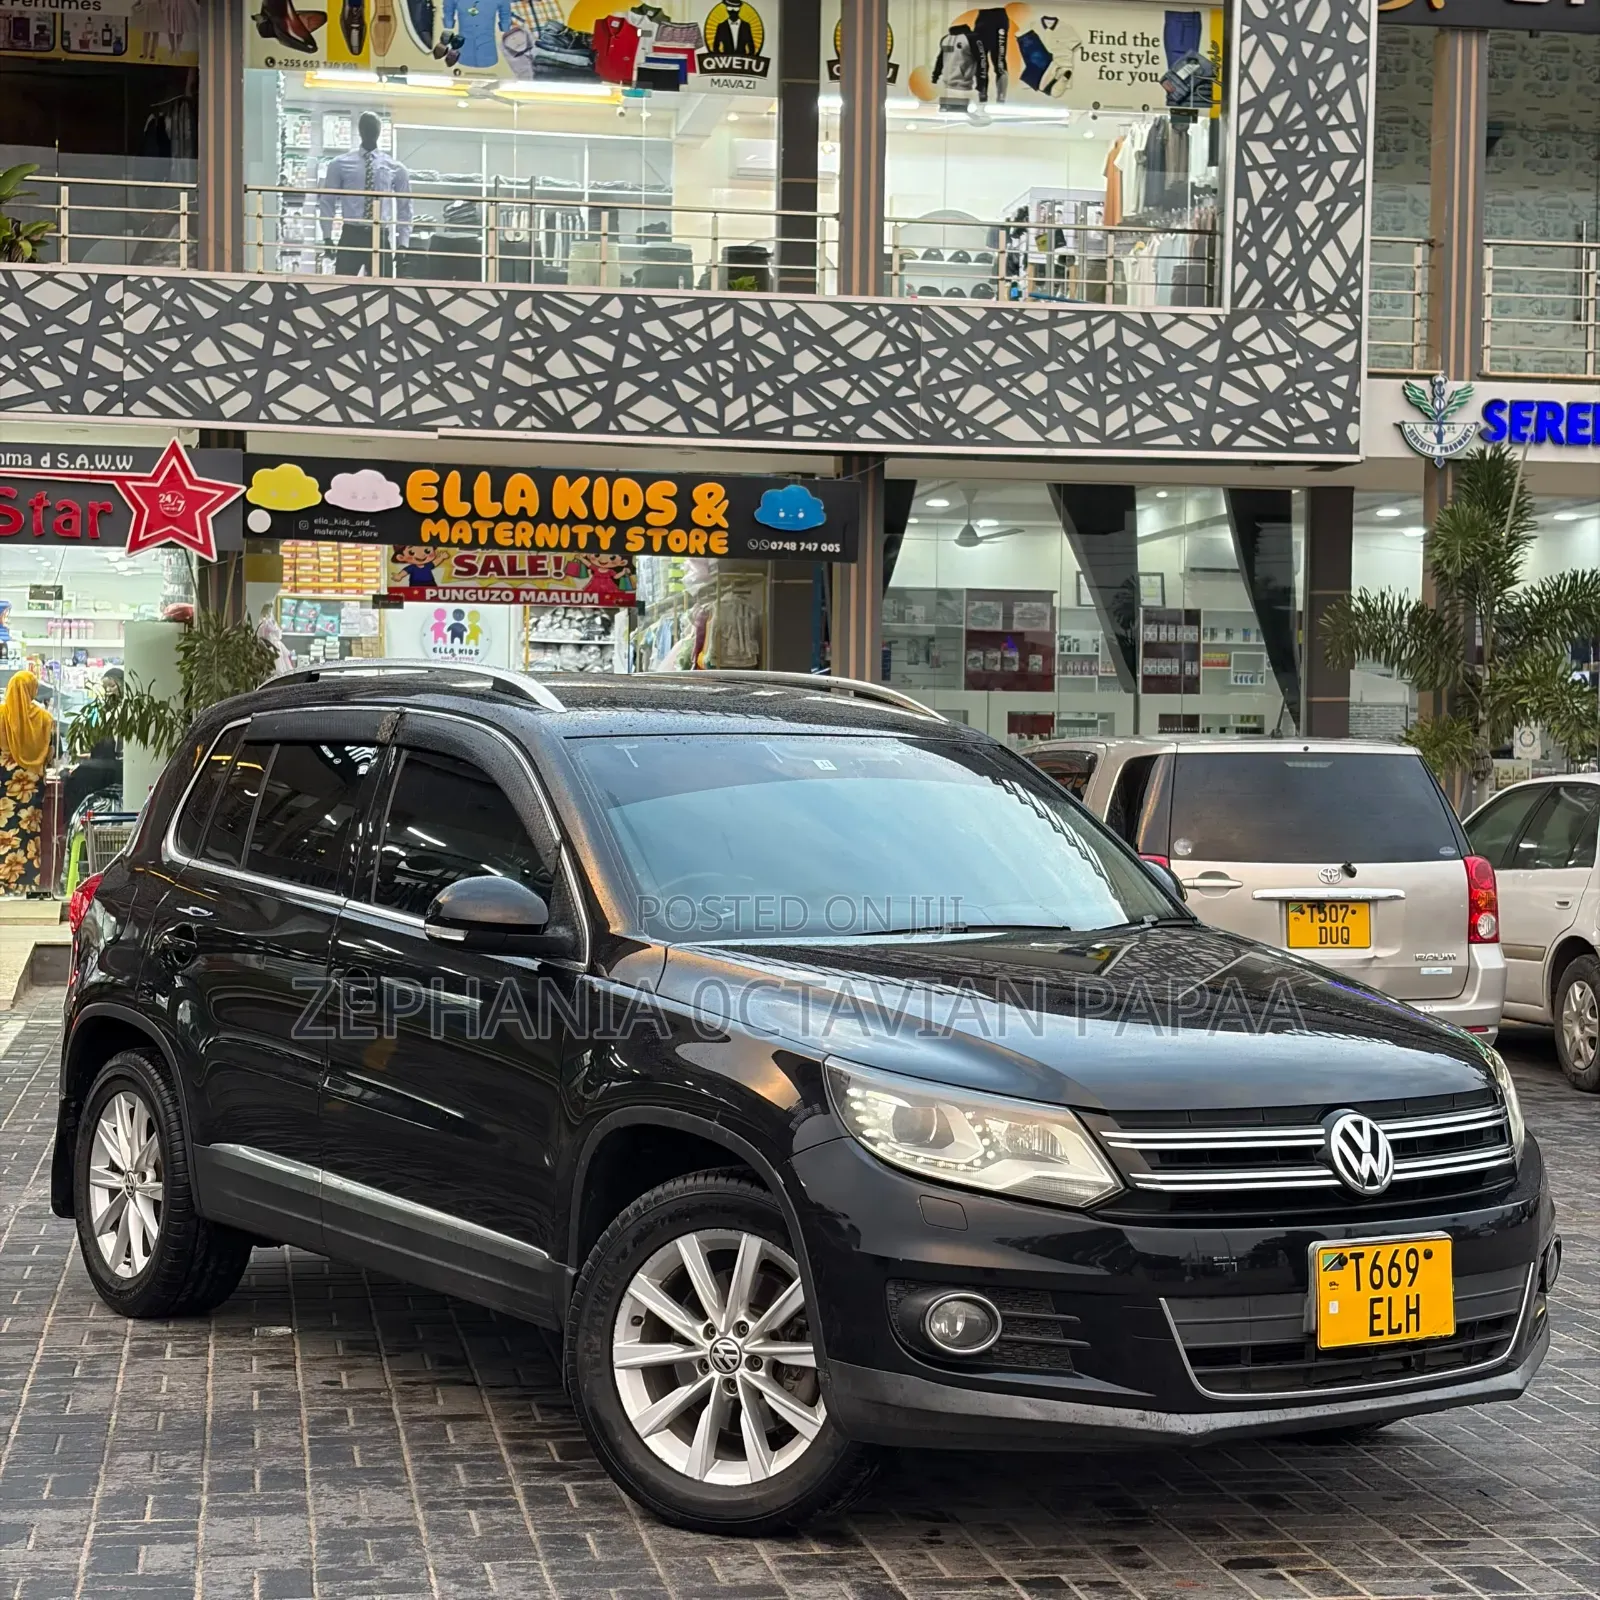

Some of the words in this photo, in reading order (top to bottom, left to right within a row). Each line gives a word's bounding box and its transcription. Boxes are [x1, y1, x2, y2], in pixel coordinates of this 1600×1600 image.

[1088, 30, 1127, 46] Find
[1132, 32, 1160, 48] the
[277, 59, 301, 68] +255
[702, 56, 765, 73] QWETU
[1080, 47, 1114, 63] best
[1120, 50, 1160, 69] style
[710, 78, 756, 90] MAVAZI
[1098, 65, 1124, 81] for
[1127, 71, 1161, 86] you
[57, 452, 133, 470] S.A.W.W
[406, 469, 540, 518] ELLA
[552, 475, 678, 526] KIDS
[691, 482, 729, 528] &
[0, 487, 113, 539] Star
[421, 518, 616, 550] MATERNITY
[625, 526, 729, 555] STORE
[770, 541, 797, 551] 0748
[799, 542, 819, 552] 747
[820, 543, 841, 553] 005
[452, 553, 566, 579] SALE!
[425, 588, 514, 603] PUNGUZO
[519, 590, 599, 604] MAALUM
[458, 648, 480, 656] KIDS
[1318, 926, 1350, 945] DUQ
[1349, 1247, 1420, 1292] T669
[1369, 1293, 1421, 1337] ELH
